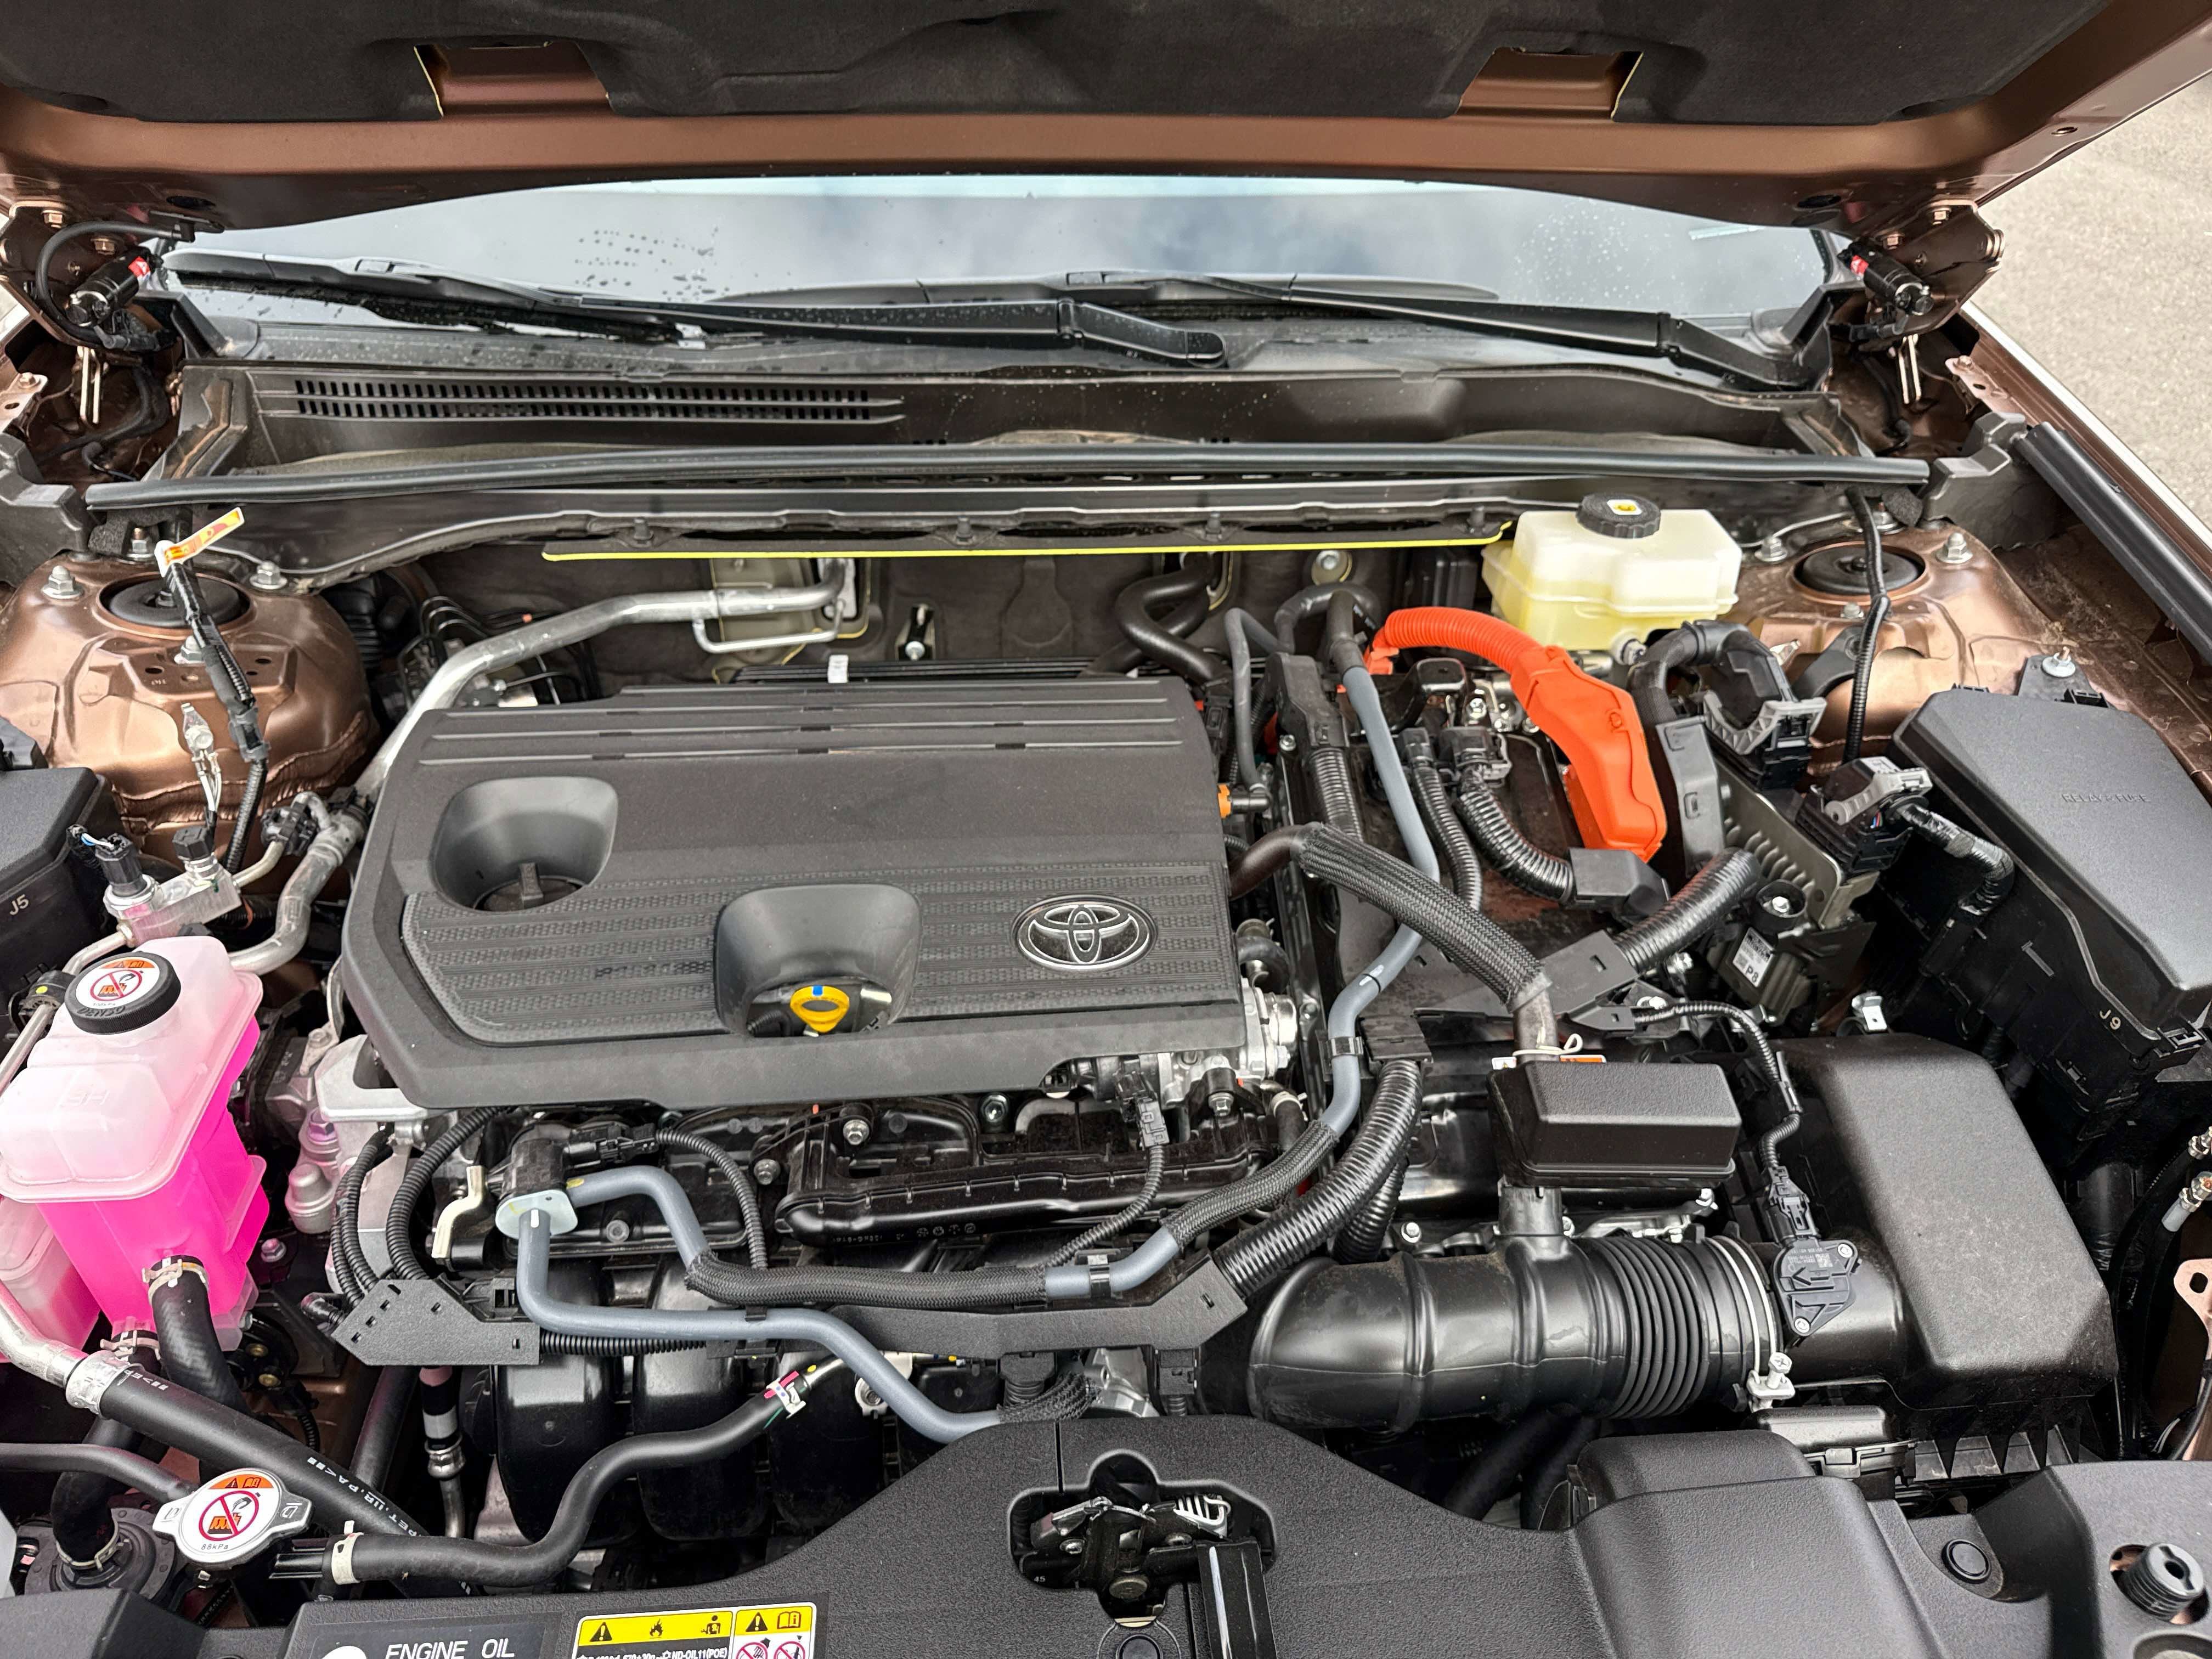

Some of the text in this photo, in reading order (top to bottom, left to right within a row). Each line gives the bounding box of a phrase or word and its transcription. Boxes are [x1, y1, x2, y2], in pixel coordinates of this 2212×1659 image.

[2115, 794, 2151, 803] FUSE
[9, 894, 29, 916] J5
[1745, 964, 1759, 983] P8
[2099, 1009, 2121, 1030] J9
[385, 1638, 515, 1659] ENGINE OIL
